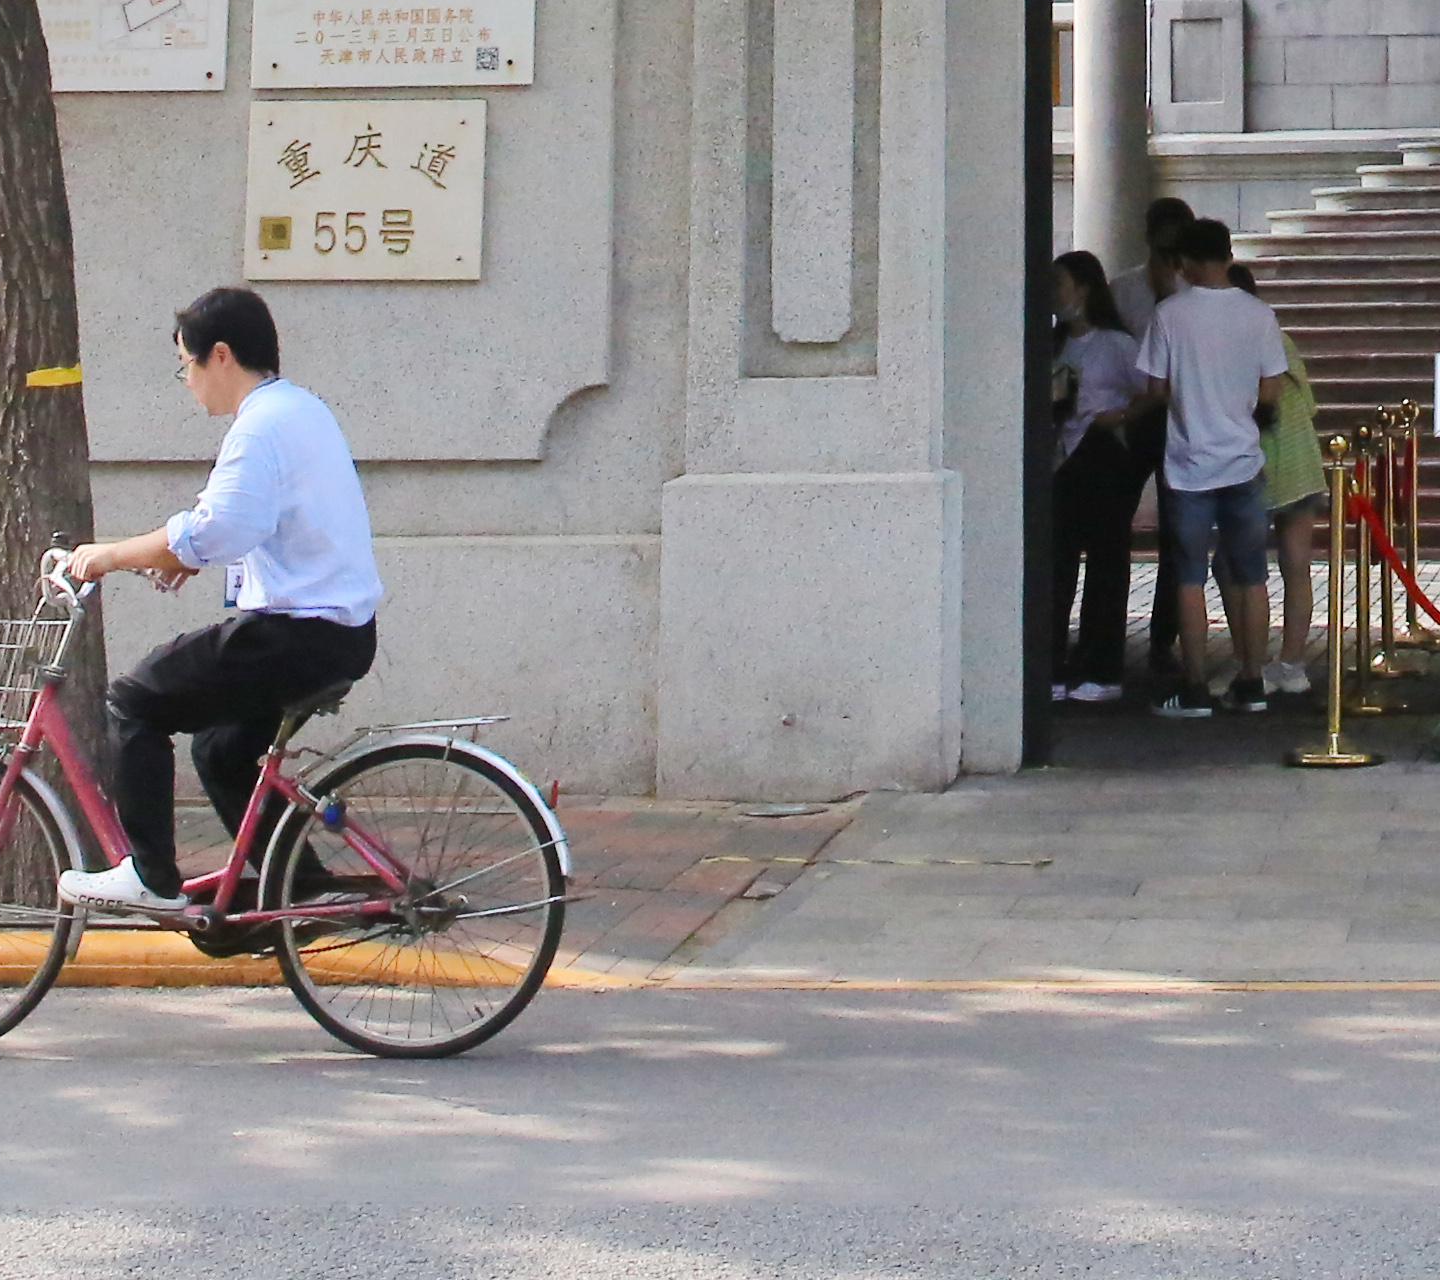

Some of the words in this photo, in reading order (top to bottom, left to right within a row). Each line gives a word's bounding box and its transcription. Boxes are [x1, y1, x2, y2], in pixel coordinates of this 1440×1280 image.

[313, 8, 474, 26] 中华人民共和国国务院
[319, 47, 464, 65] 天津市人民政府立
[276, 123, 456, 190] 重庆道
[313, 208, 415, 255] 55号
[78, 894, 125, 909] crocs
